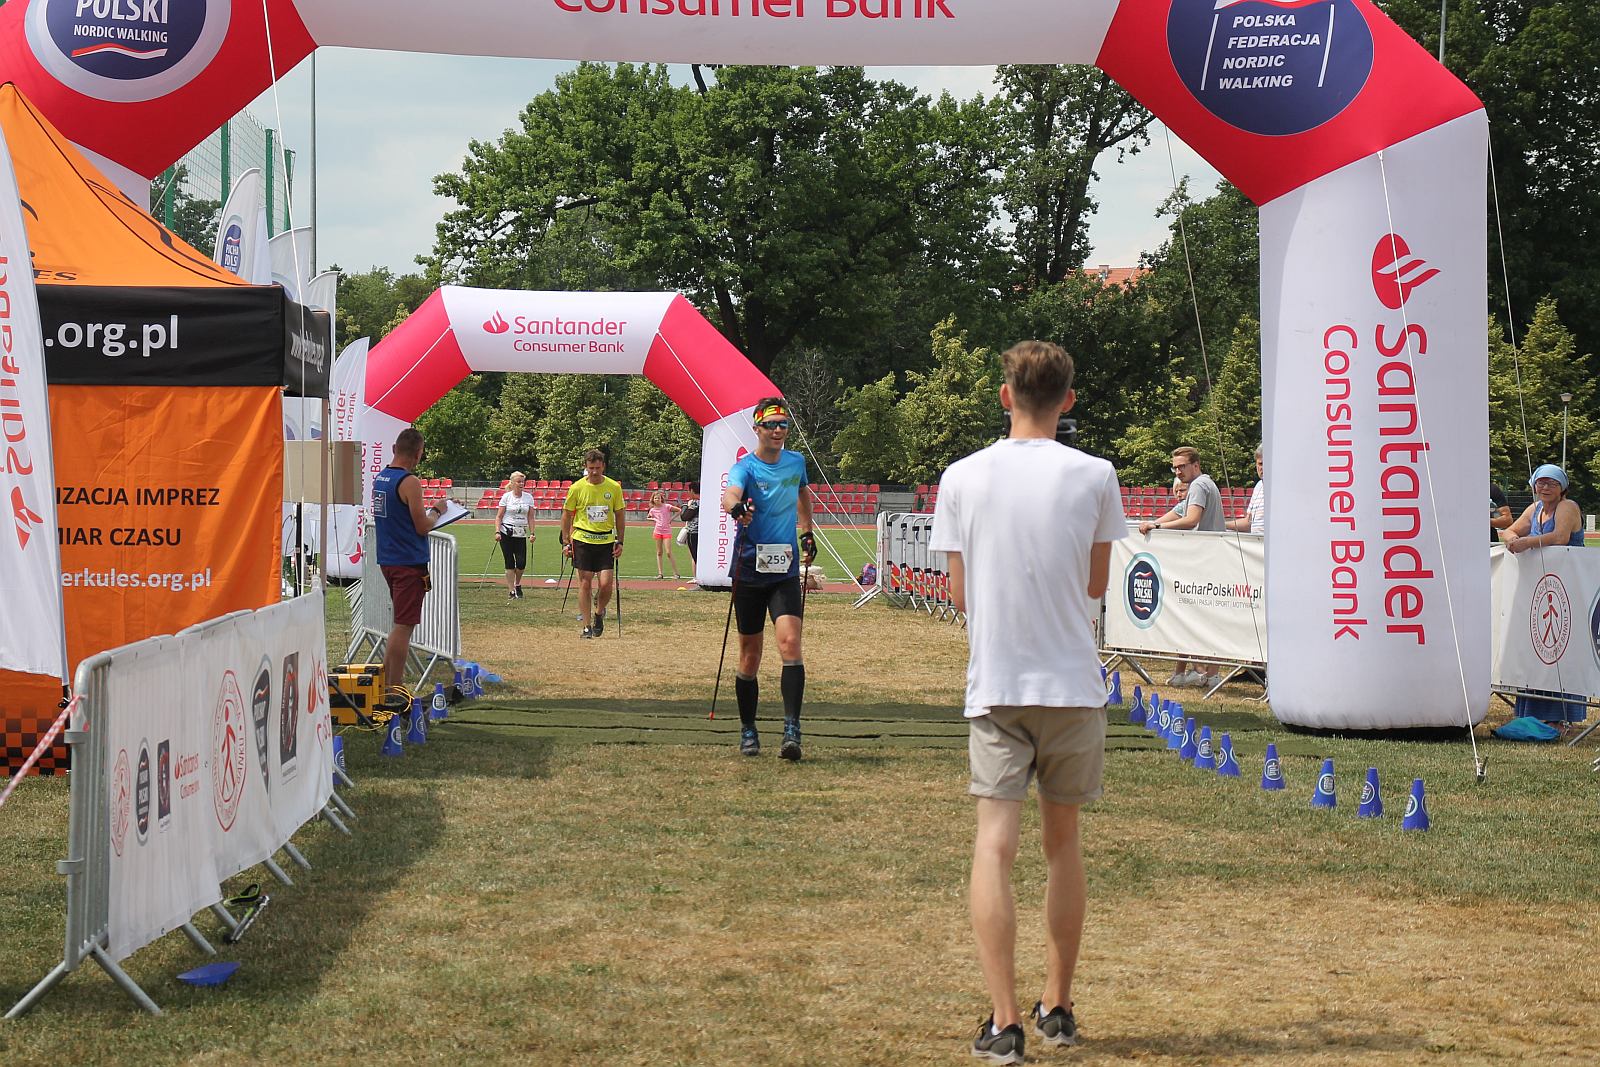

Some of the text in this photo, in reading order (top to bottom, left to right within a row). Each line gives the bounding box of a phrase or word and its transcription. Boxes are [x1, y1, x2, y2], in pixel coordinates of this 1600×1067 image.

[75, 0, 168, 24] POLSKI
[1232, 14, 1296, 28] POLSKA
[73, 24, 168, 43] NORDIC WALKING
[1227, 33, 1321, 49] FEDERACJA
[1222, 54, 1286, 70] NORDIC
[1219, 74, 1293, 90] WALKING
[513, 315, 627, 336] Santander
[45, 314, 179, 357] .org.pl
[513, 339, 625, 353] Consumer Bank
[370, 441, 383, 473] Bank
[1322, 324, 1368, 641] Consumer Bank
[1374, 322, 1435, 646] Santander
[136, 487, 220, 506] IMPREZ
[109, 527, 182, 546] CZASU
[717, 538, 729, 569] Bank
[766, 555, 786, 565] 259
[60, 567, 212, 592] erkules.org.pl
[1133, 588, 1153, 599] POLSKI
[1174, 580, 1262, 602] PucharPolskiNW.pl
